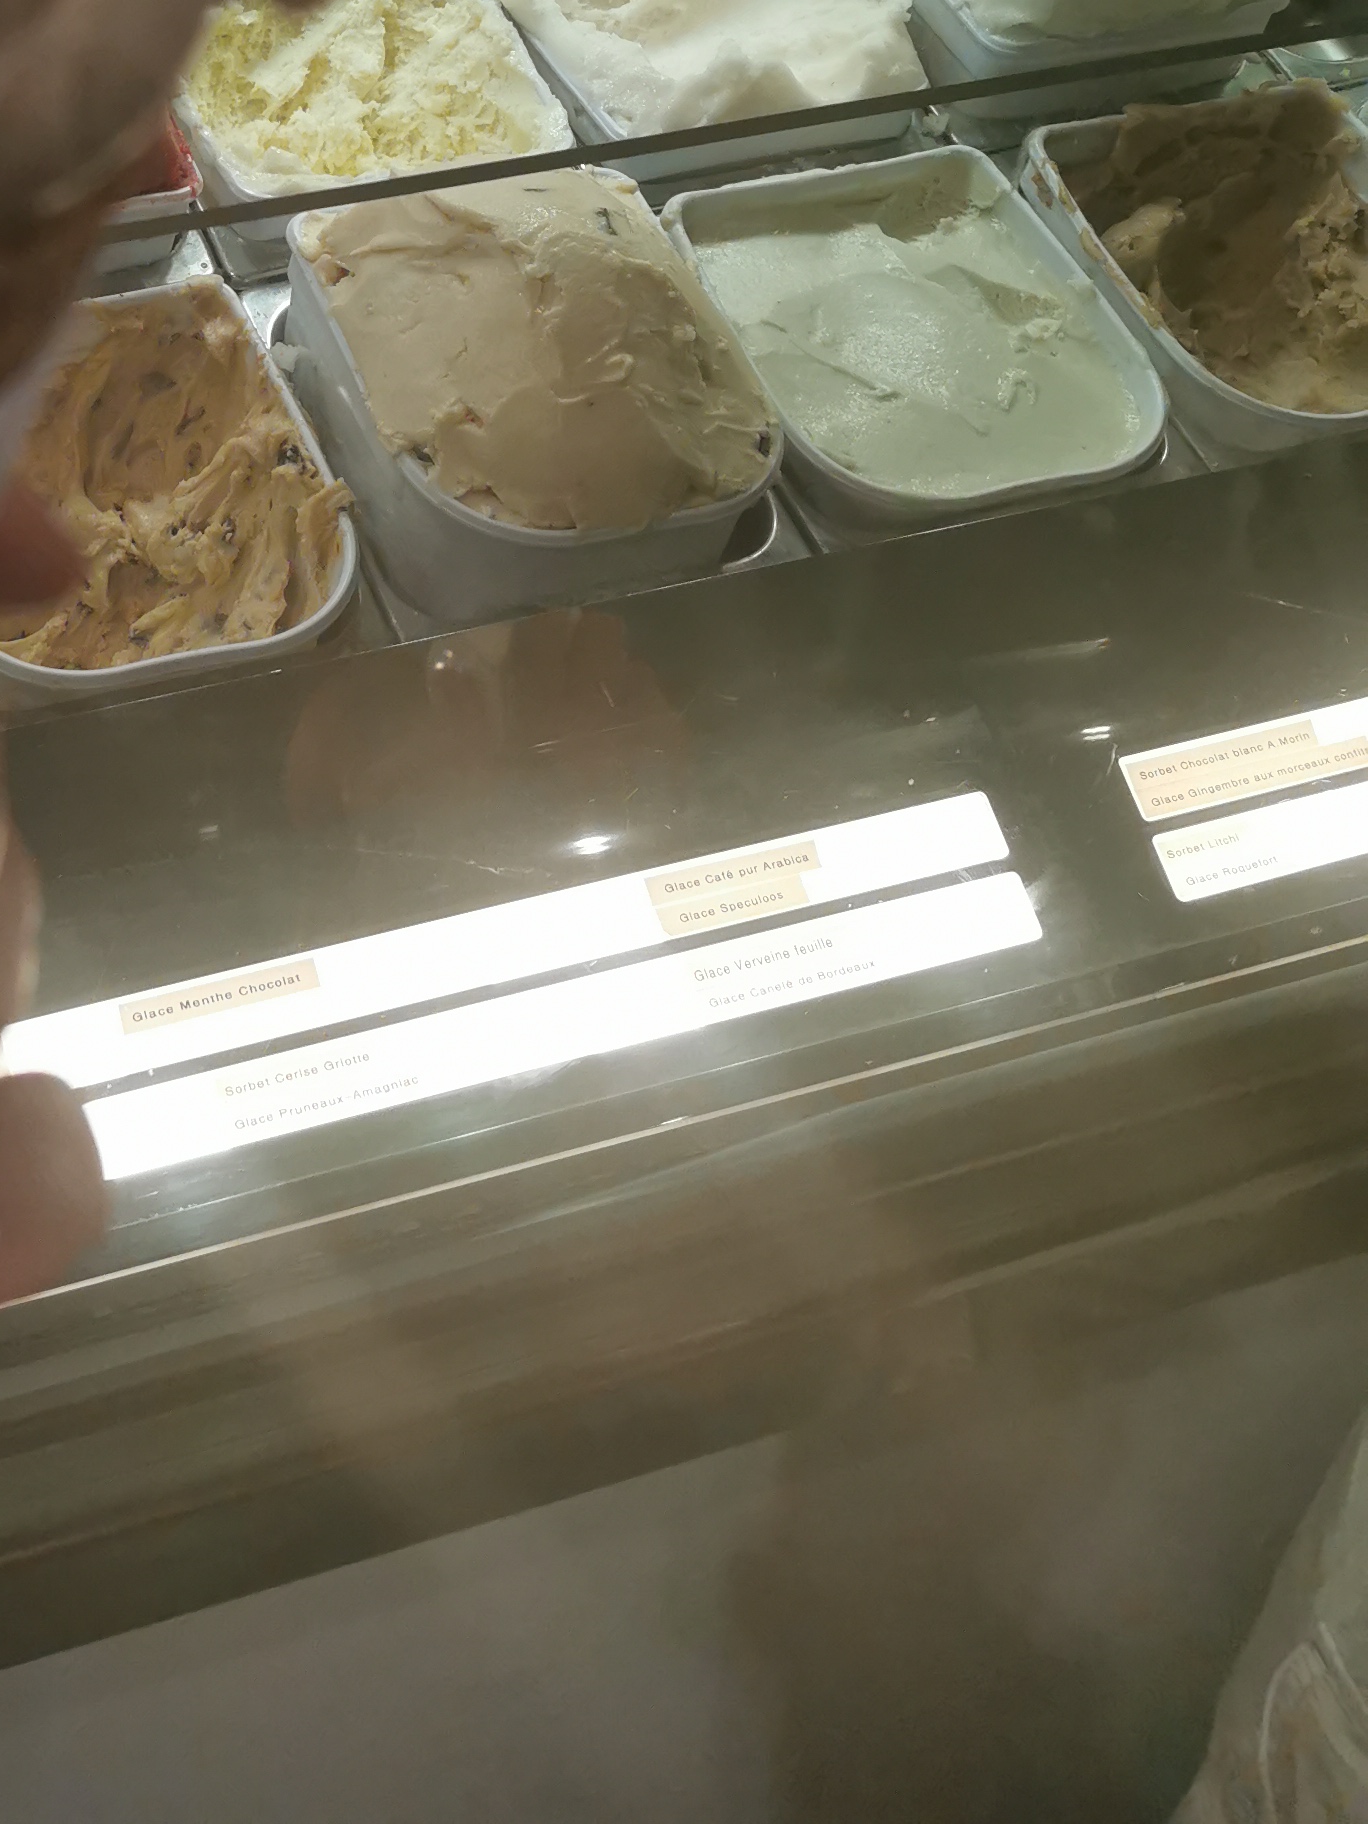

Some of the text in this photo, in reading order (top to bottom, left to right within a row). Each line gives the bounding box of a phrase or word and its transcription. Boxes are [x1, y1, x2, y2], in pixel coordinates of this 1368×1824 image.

[1139, 764, 1178, 781] Sorbet
[1180, 751, 1230, 771] Chocolat
[1232, 742, 1264, 758] blanc
[1151, 792, 1185, 807] Glace
[1187, 776, 1250, 799] Gingembre
[1253, 771, 1273, 782] aux
[1277, 757, 1331, 777] morceaux
[1166, 833, 1240, 859] Sorbet Litchi
[664, 853, 810, 894] Glace Café pur Arabica
[1186, 855, 1279, 886] Glace Roquefort
[679, 891, 784, 924] Glace Speculoos
[693, 937, 833, 982] Glace Verveine feuille
[132, 973, 302, 1023] Glace Menthe Chocolat
[709, 991, 745, 1008] Glace
[798, 976, 813, 986] de
[817, 959, 875, 981] Bordeaux
[225, 1053, 370, 1097] Sorbet Cerise Griotte
[234, 1113, 274, 1131] Glace
